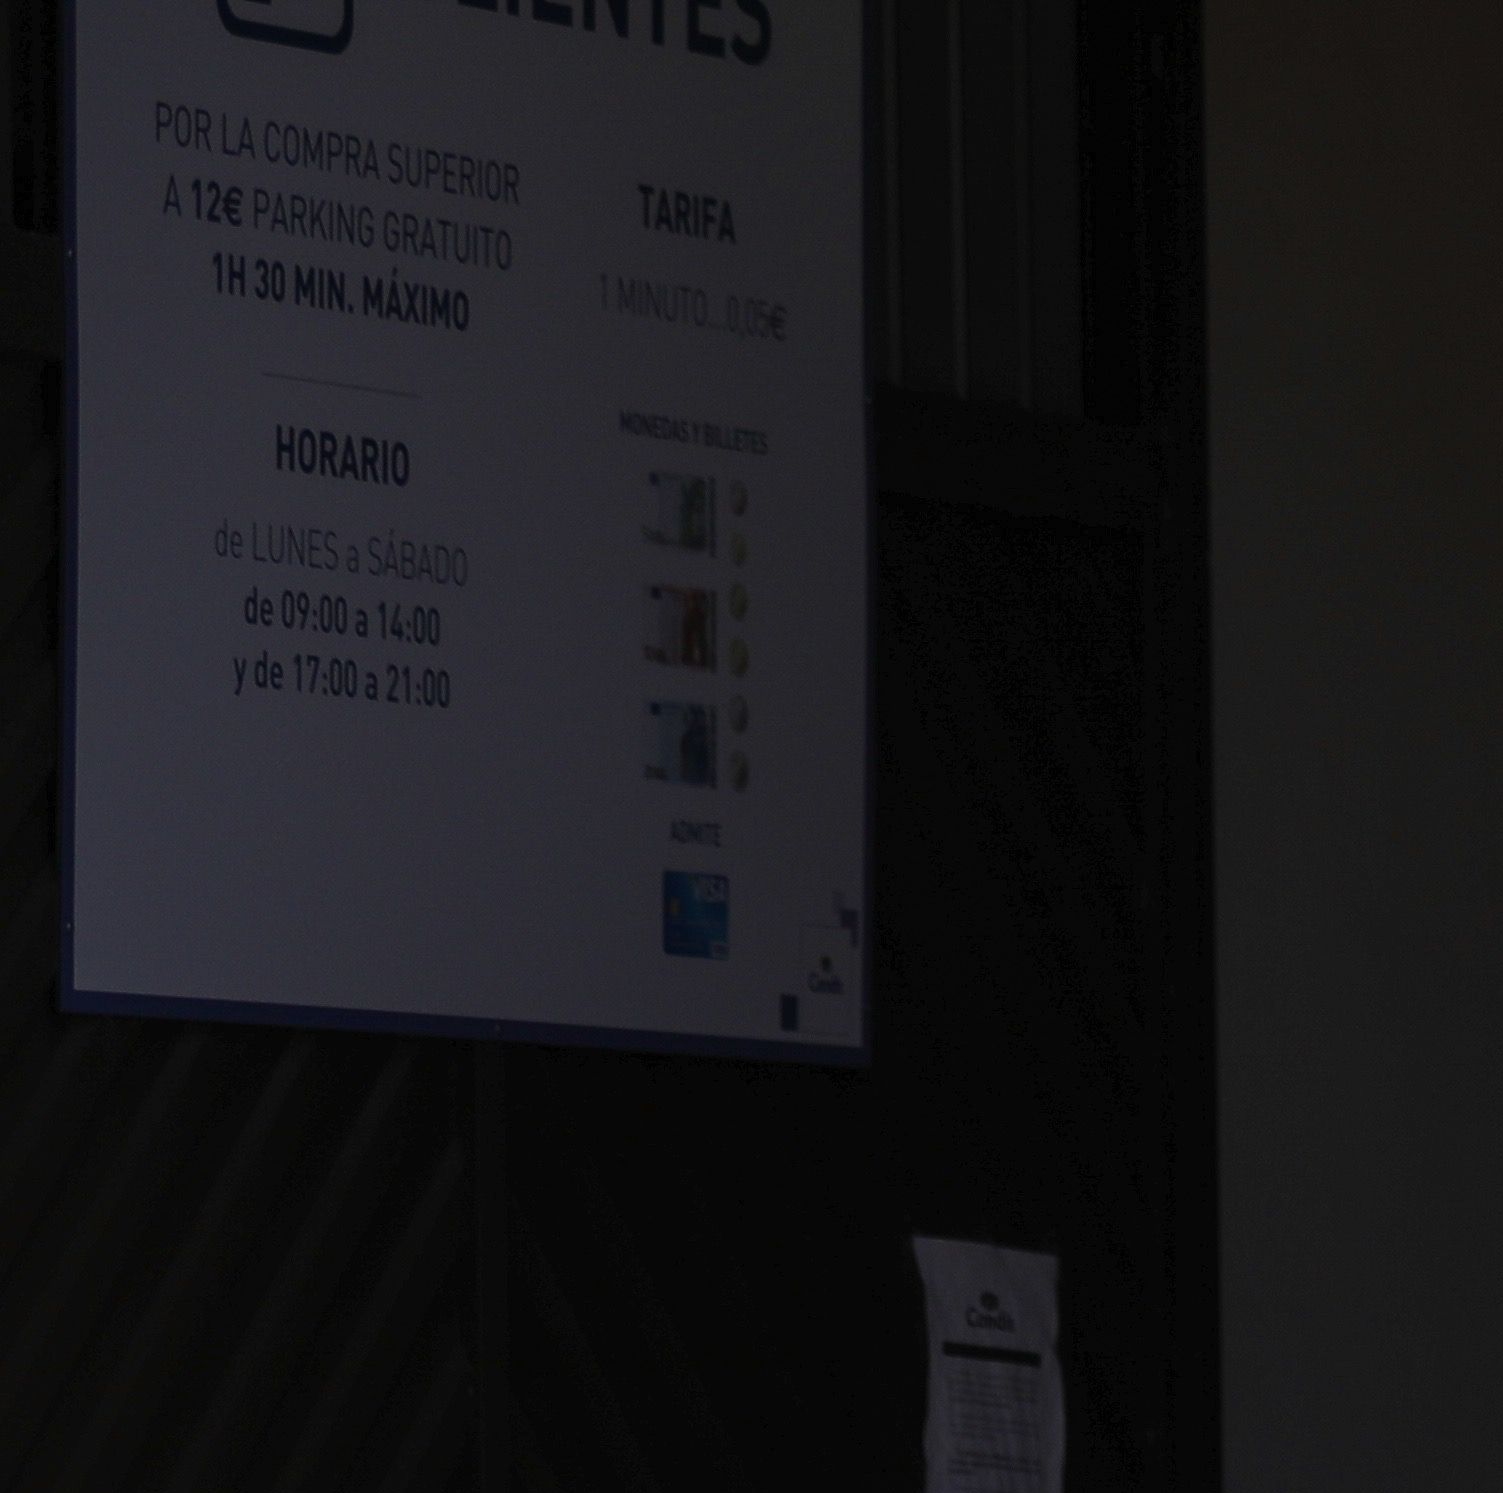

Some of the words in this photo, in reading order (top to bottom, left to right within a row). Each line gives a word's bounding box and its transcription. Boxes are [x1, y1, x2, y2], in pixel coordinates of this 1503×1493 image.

[155, 102, 211, 151] POR
[222, 113, 255, 160] LA
[264, 120, 379, 180] COMPRA
[388, 144, 520, 204] SUPERIOR
[163, 175, 181, 217] A
[191, 179, 243, 227] 12€
[253, 189, 374, 248] PARKING
[384, 210, 512, 271] GRATUITO
[638, 184, 736, 245] TARIFA
[213, 252, 245, 297] 1H
[255, 259, 285, 302] 30
[294, 265, 354, 314] MIN.
[363, 267, 470, 331] MÁXIMO
[276, 424, 410, 486] HORARIO
[215, 518, 243, 559] de
[252, 522, 339, 571] LUNES
[347, 544, 359, 573] a
[368, 529, 468, 587] SÁBADO
[244, 587, 273, 626] de
[282, 590, 348, 635] 09:00
[356, 608, 368, 638] a
[379, 602, 440, 646] 14:00
[234, 656, 246, 696] y
[255, 651, 283, 690] de
[294, 655, 357, 698] 17:00
[365, 672, 378, 701] a
[387, 664, 450, 708] 21:00
